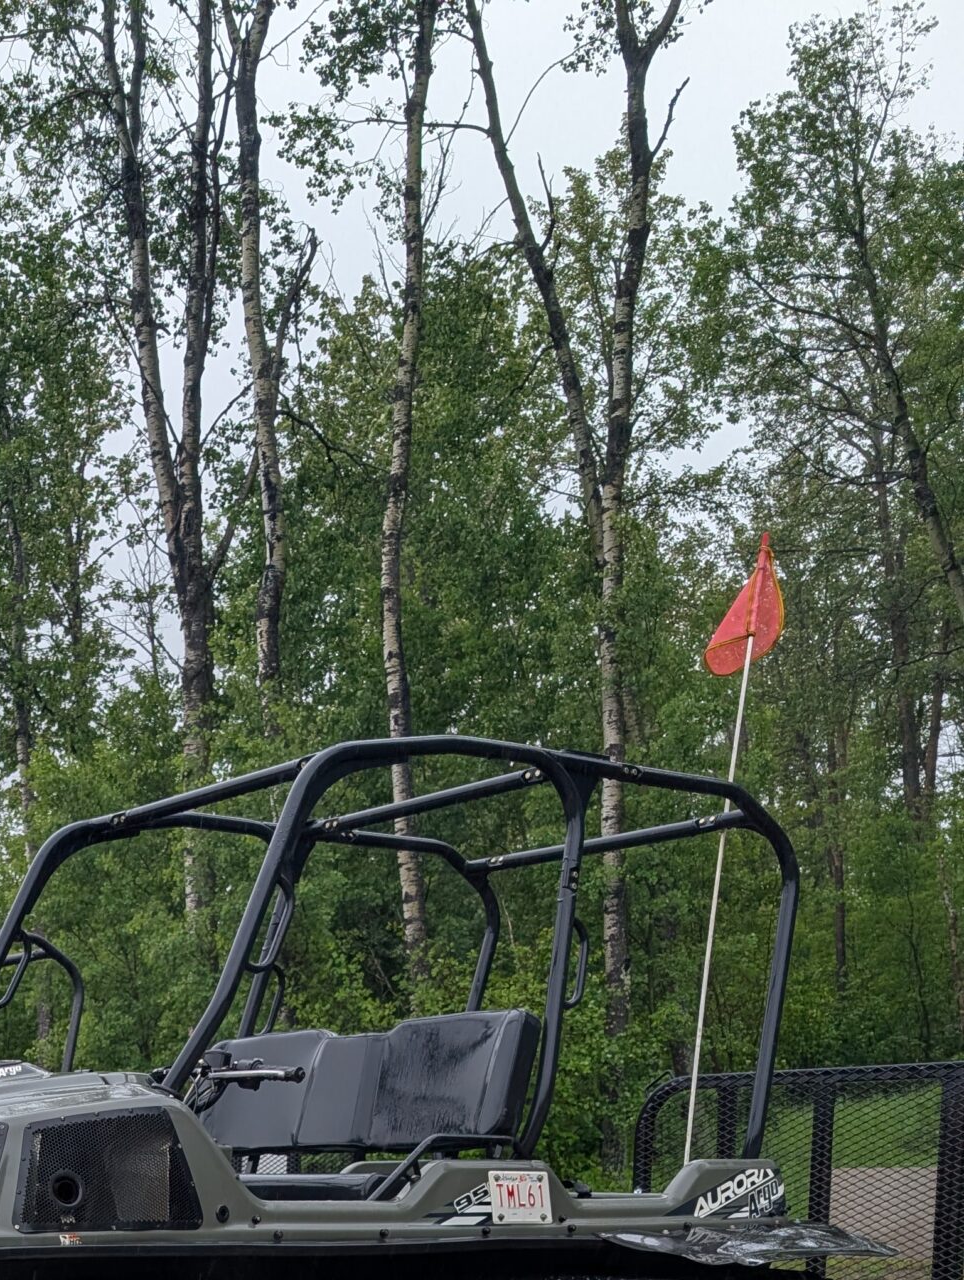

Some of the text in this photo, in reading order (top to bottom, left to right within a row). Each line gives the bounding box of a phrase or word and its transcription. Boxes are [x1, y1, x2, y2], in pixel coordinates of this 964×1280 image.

[453, 1182, 492, 1214] 95
[496, 1183, 544, 1209] TML61
[693, 1168, 775, 1218] AURORA
[747, 1179, 779, 1219] Argo
